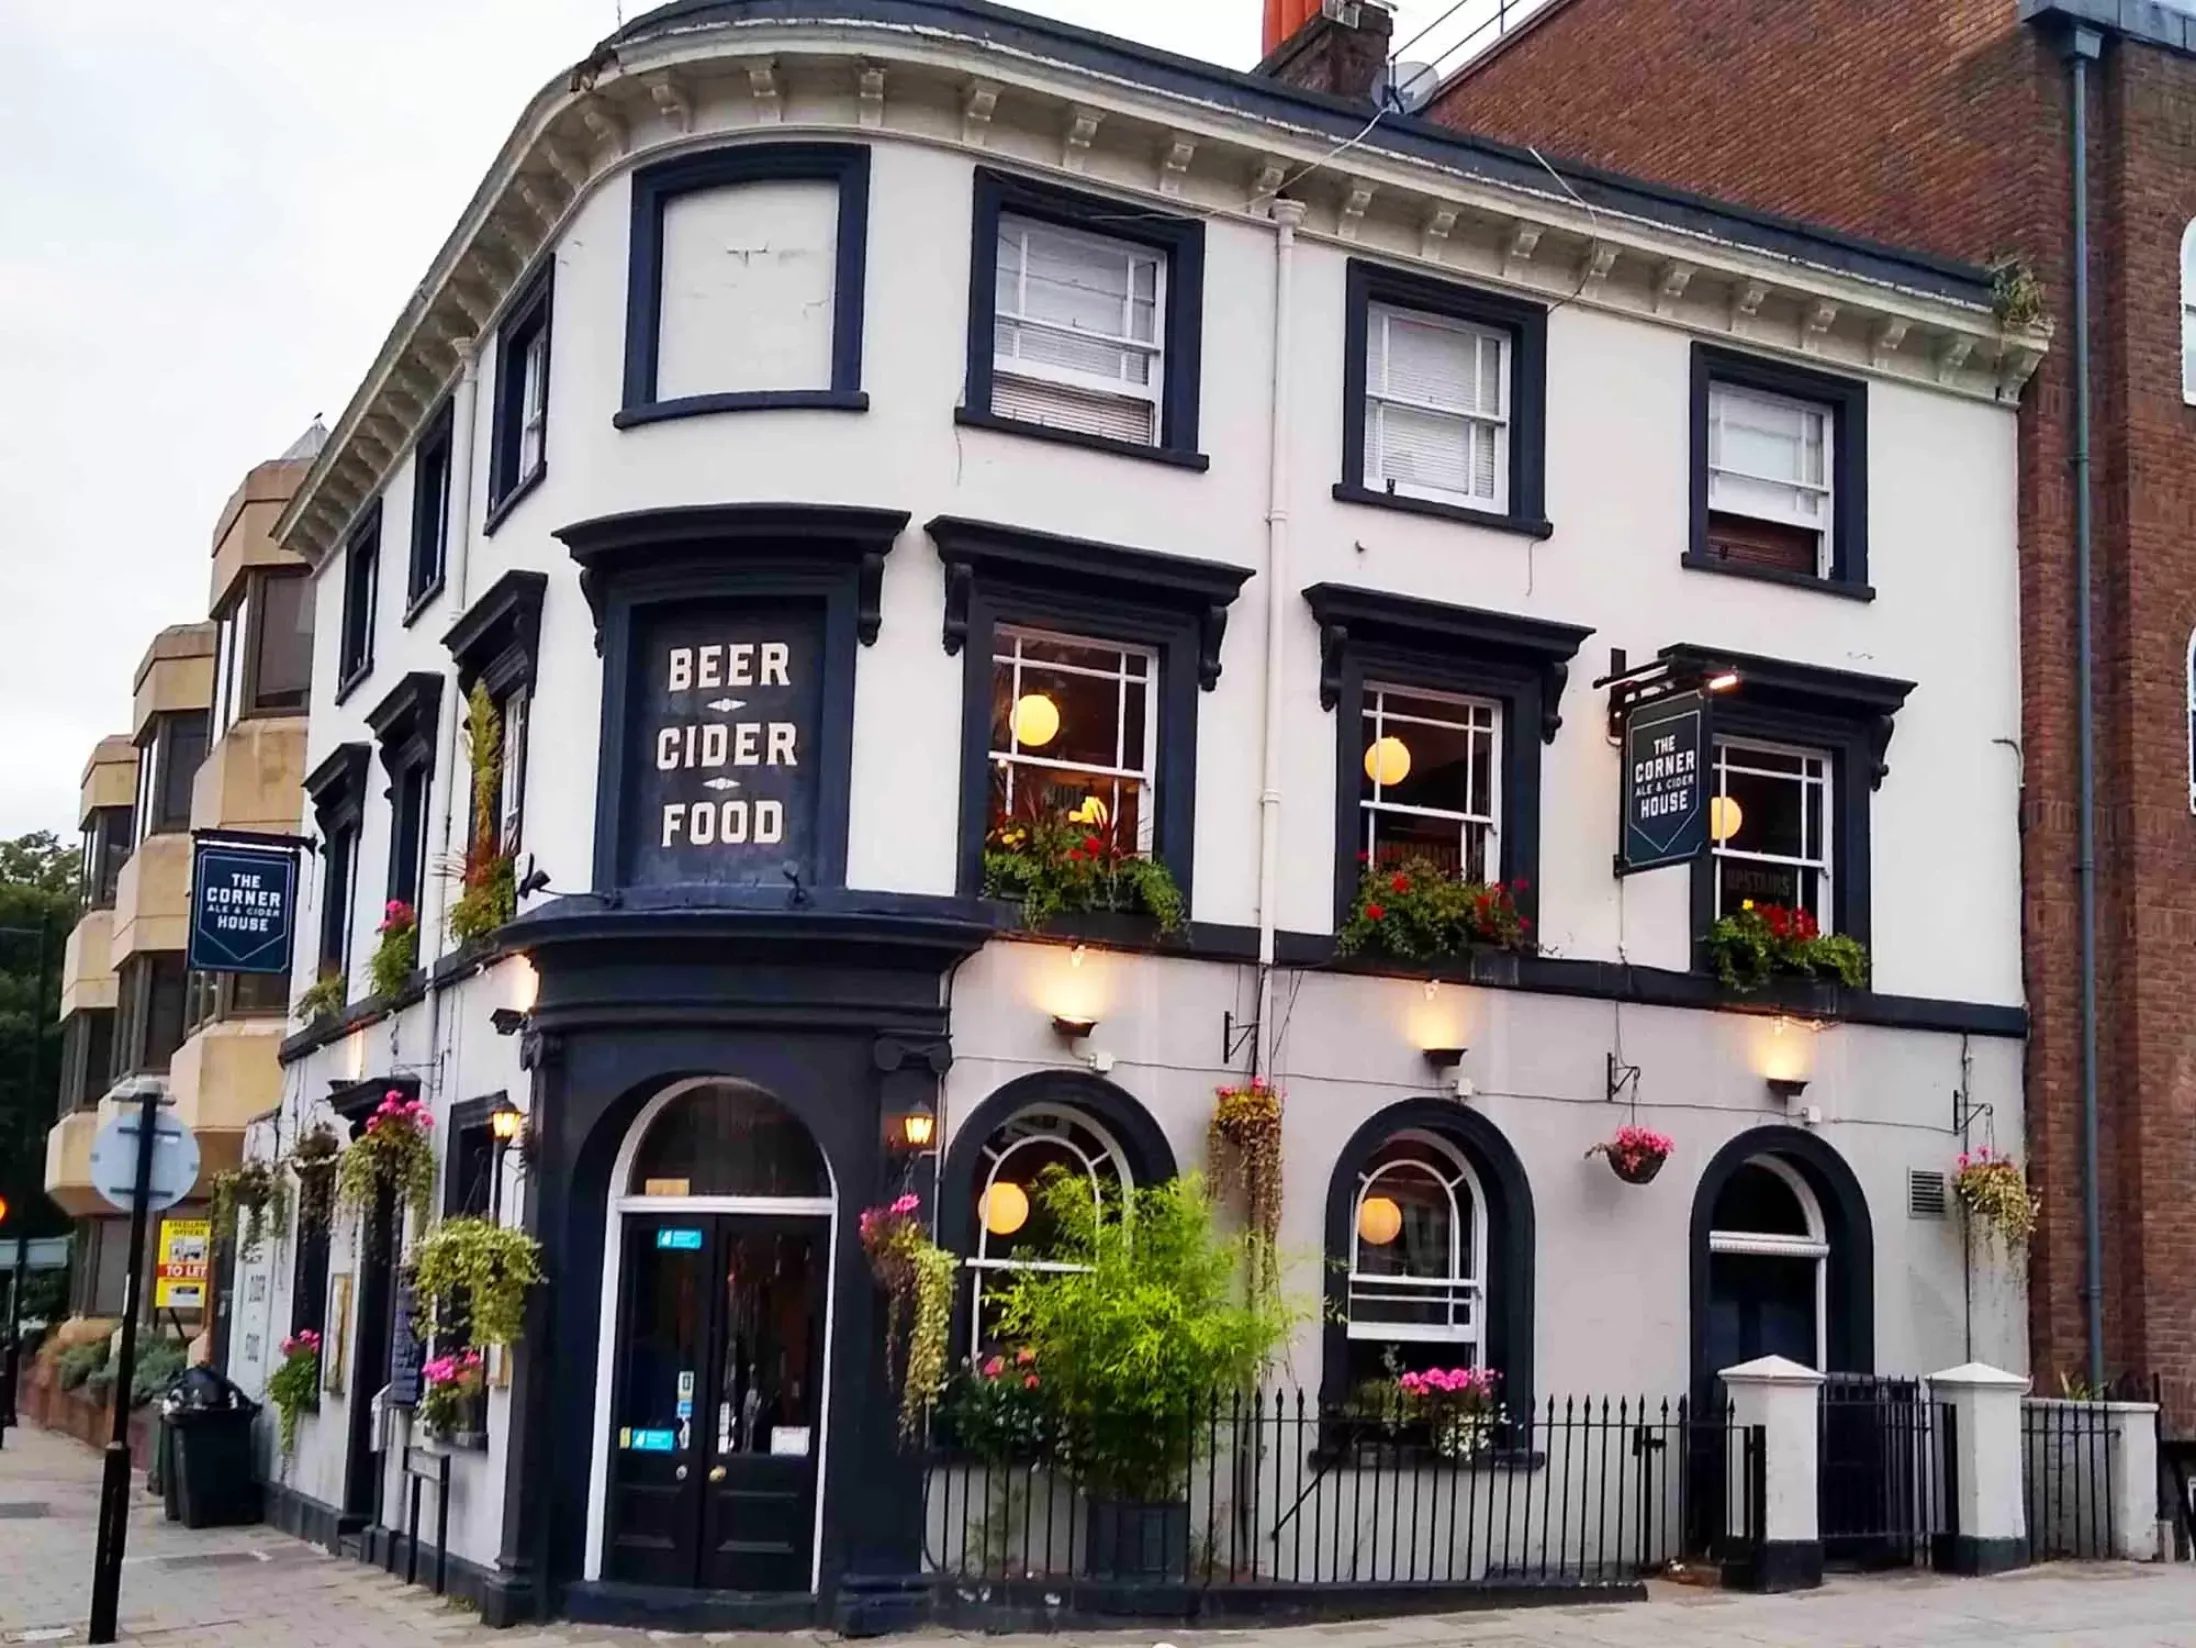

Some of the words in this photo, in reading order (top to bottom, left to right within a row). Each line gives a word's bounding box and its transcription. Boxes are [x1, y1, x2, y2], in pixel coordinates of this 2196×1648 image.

[668, 643, 791, 692] BEER
[656, 722, 798, 770] CIDER
[1654, 735, 1676, 755] THE
[1635, 750, 1695, 783] CORNER
[1635, 784, 1652, 797] ALE
[1656, 782, 1662, 792] &
[1666, 774, 1694, 789] CIDER
[1641, 789, 1688, 819] HOUSE
[661, 800, 783, 847] FOOD
[231, 873, 261, 888] THE
[206, 887, 281, 908] CORNER
[207, 904, 229, 914] ALE
[246, 907, 280, 917] CIDER
[217, 915, 269, 932] HOUSE
[167, 1266, 183, 1277] TO
[186, 1266, 207, 1277] LET
